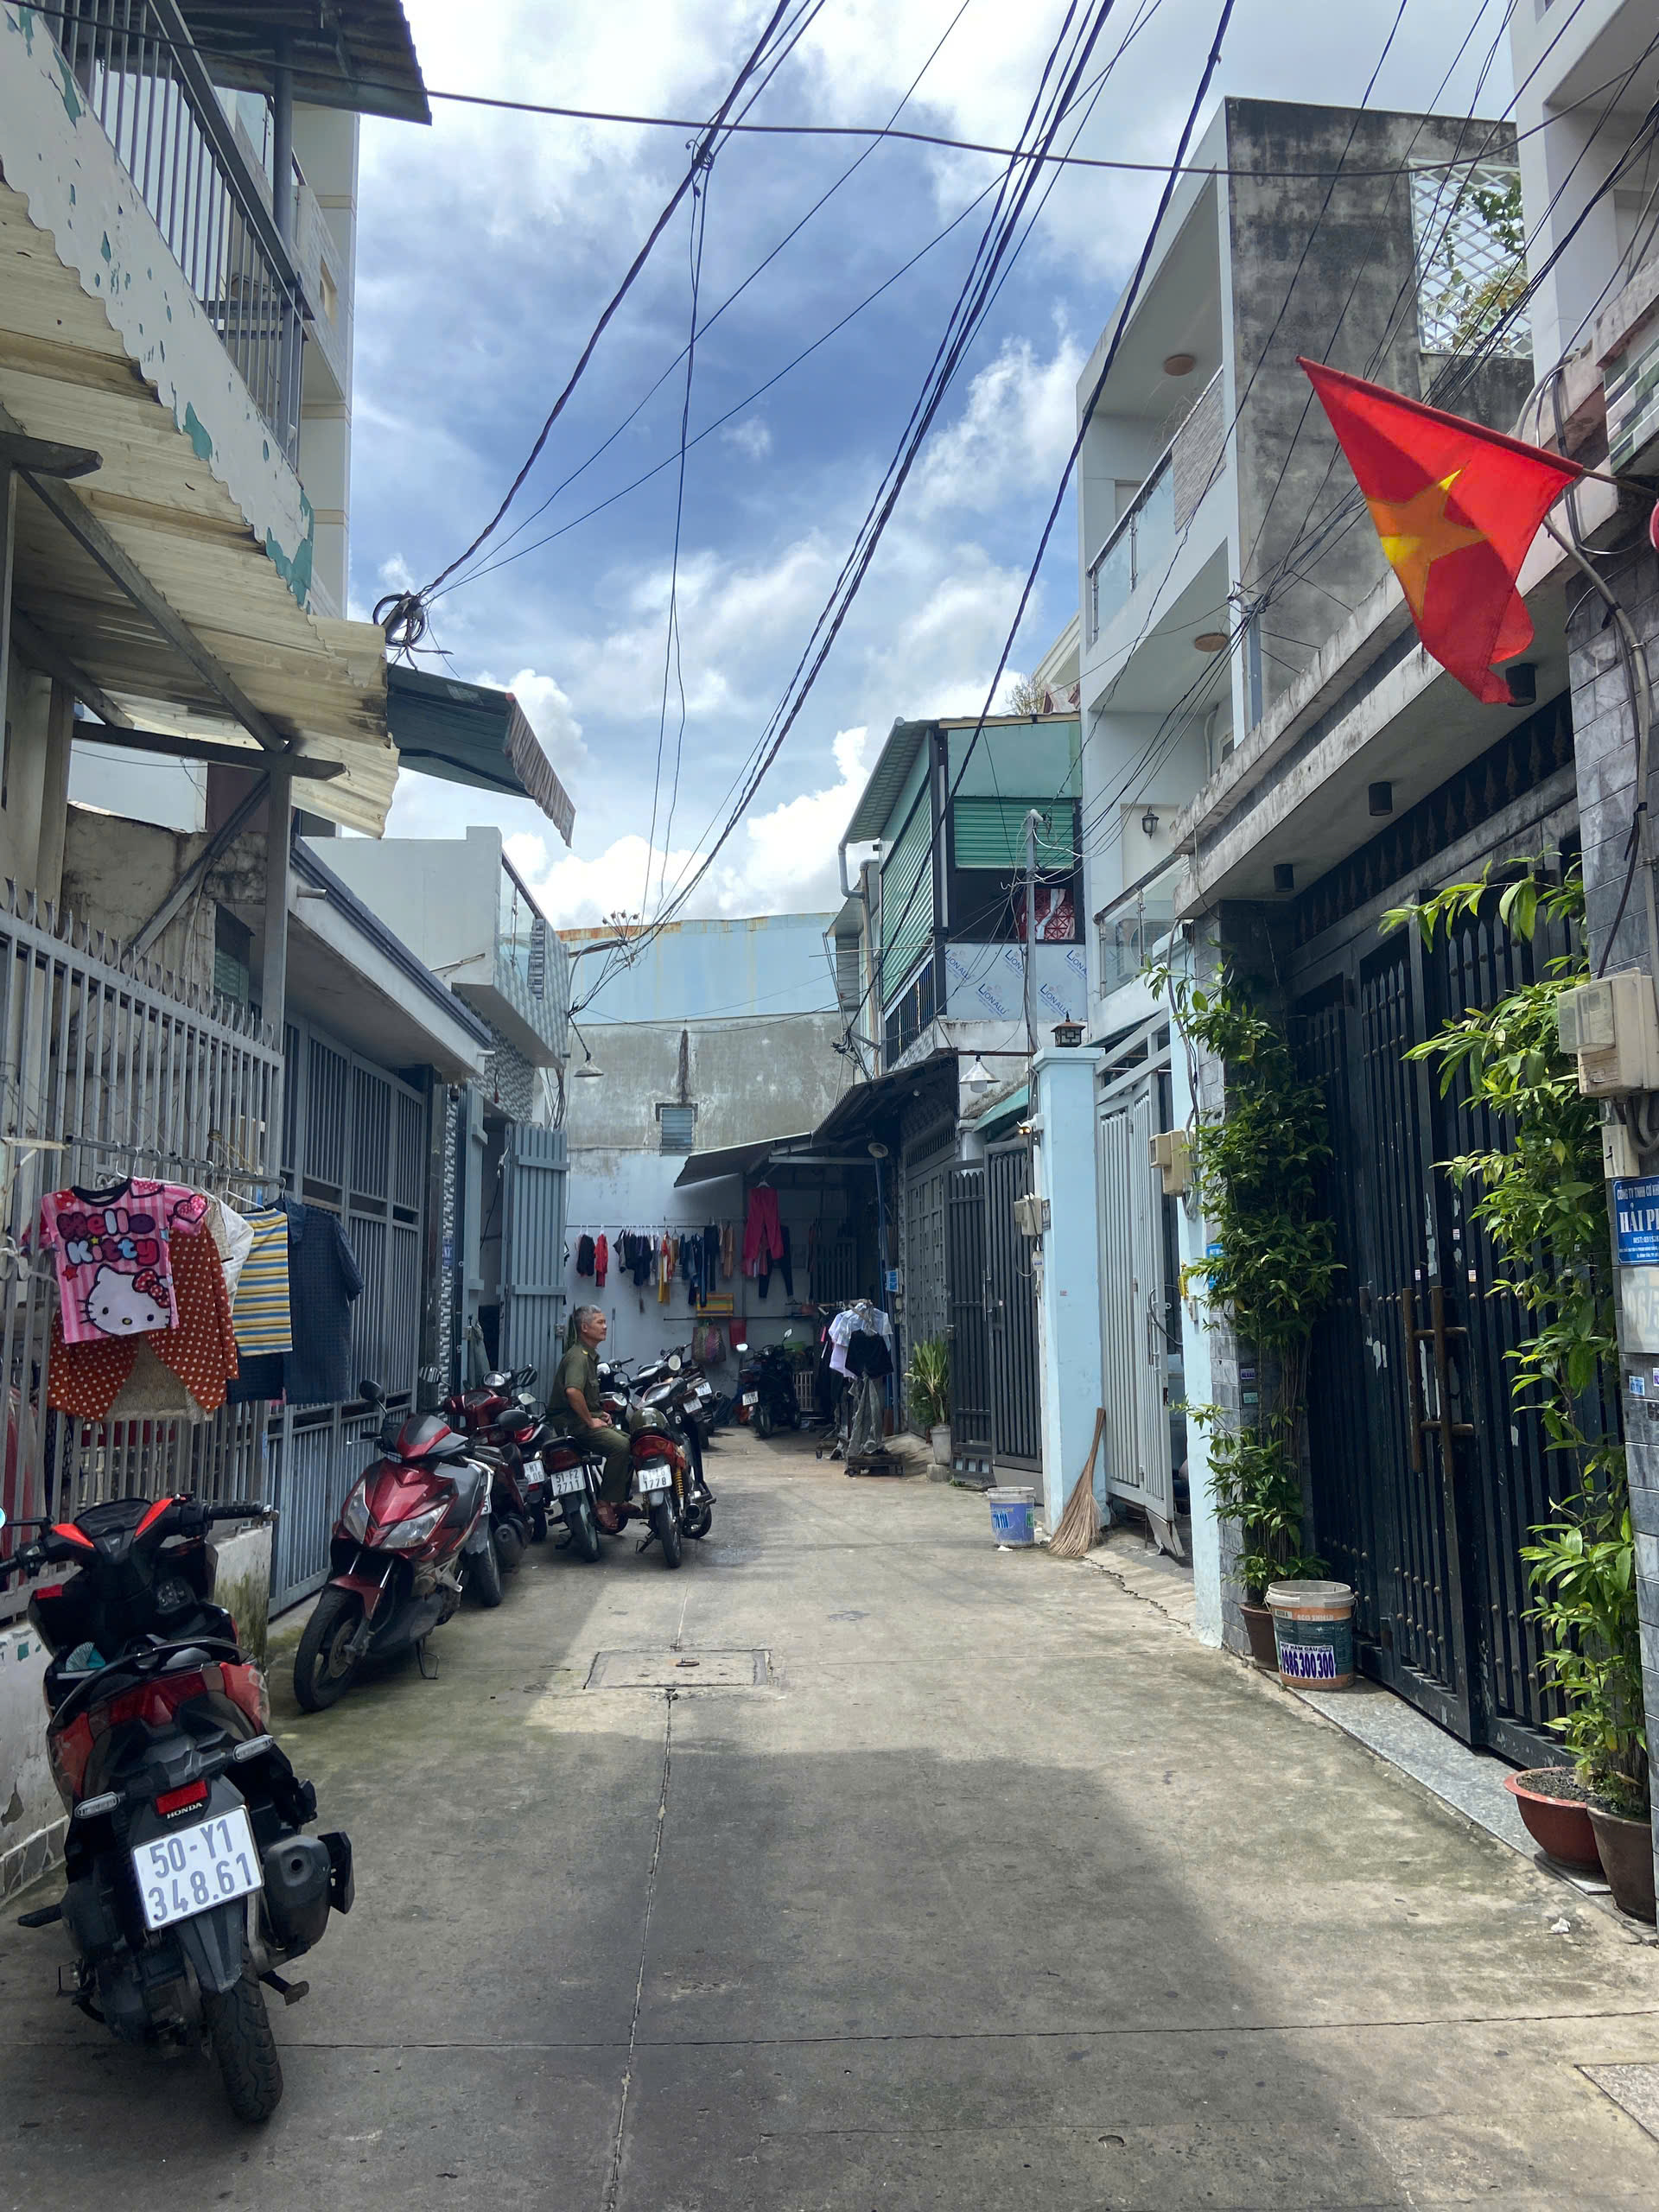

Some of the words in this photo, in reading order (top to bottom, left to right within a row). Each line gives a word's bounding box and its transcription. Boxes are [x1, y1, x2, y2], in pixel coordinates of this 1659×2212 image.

[978, 983, 1007, 1015] LIONALU
[56, 1207, 156, 1240] Hello
[1619, 1202, 1643, 1233] HẢI
[65, 1236, 160, 1266] Kitty
[556, 1470, 579, 1483] 51-F2
[557, 1479, 581, 1493] 2711
[643, 1477, 667, 1490] 1778
[167, 1802, 203, 1819] HONDA
[149, 1819, 232, 1878] 50-Y1
[148, 1853, 252, 1921] 348.61
